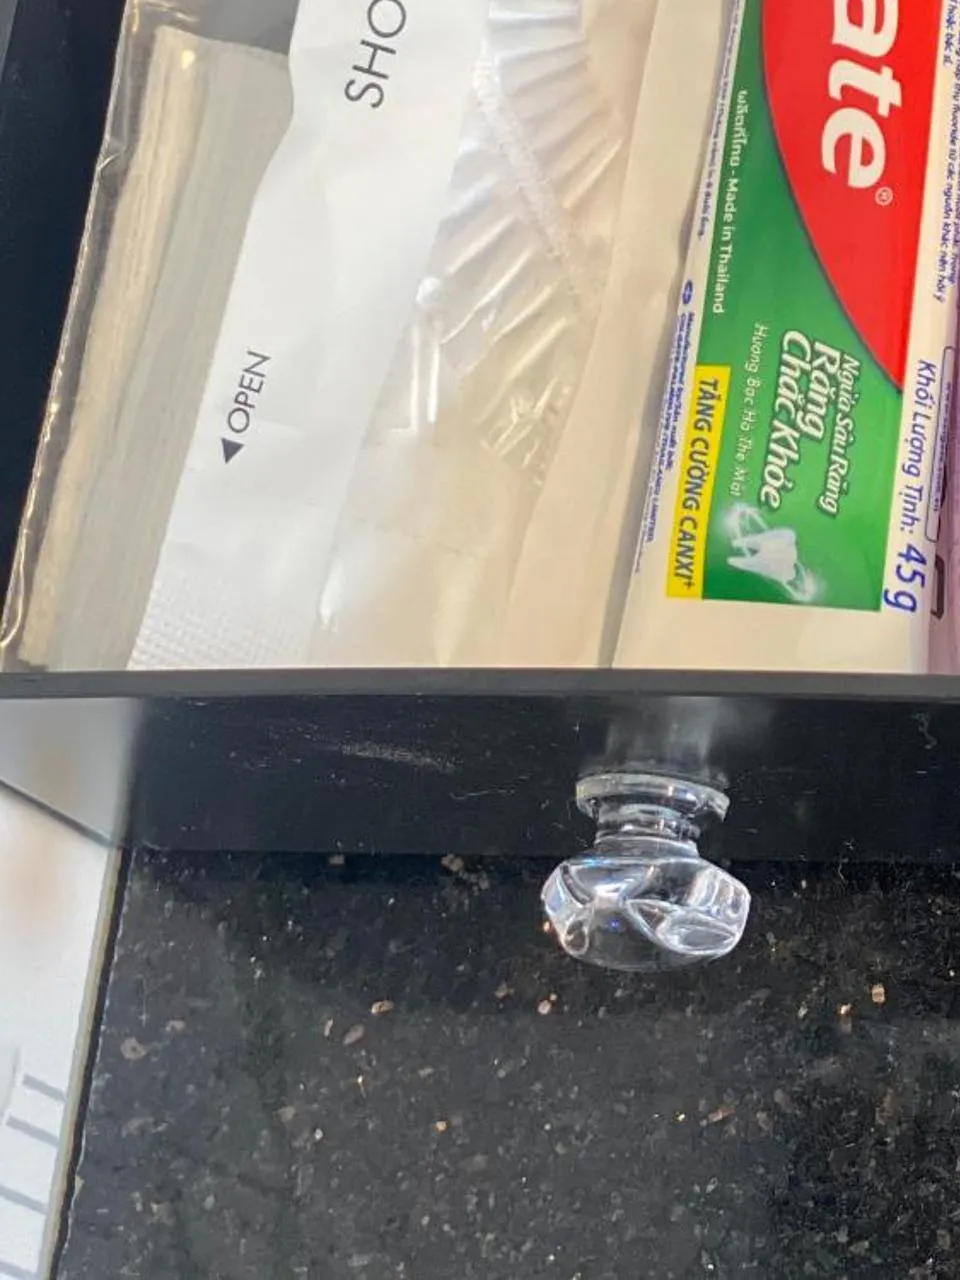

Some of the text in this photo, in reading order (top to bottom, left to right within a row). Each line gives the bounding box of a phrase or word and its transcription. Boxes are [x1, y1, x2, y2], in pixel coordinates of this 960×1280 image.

[720, 225, 735, 242] in
[722, 178, 738, 222] Made
[711, 243, 732, 314] Thailand
[227, 350, 272, 434] OPEN
[693, 377, 722, 433] TĂNG
[801, 340, 838, 440] Răng
[913, 360, 939, 408] Khối
[760, 330, 814, 510] Chắc Khỏe
[817, 353, 861, 513] Ngừa Sâu Răng
[900, 411, 930, 477] Lượng
[681, 435, 713, 511] CƯỜNG
[894, 483, 922, 534] Tịnh:
